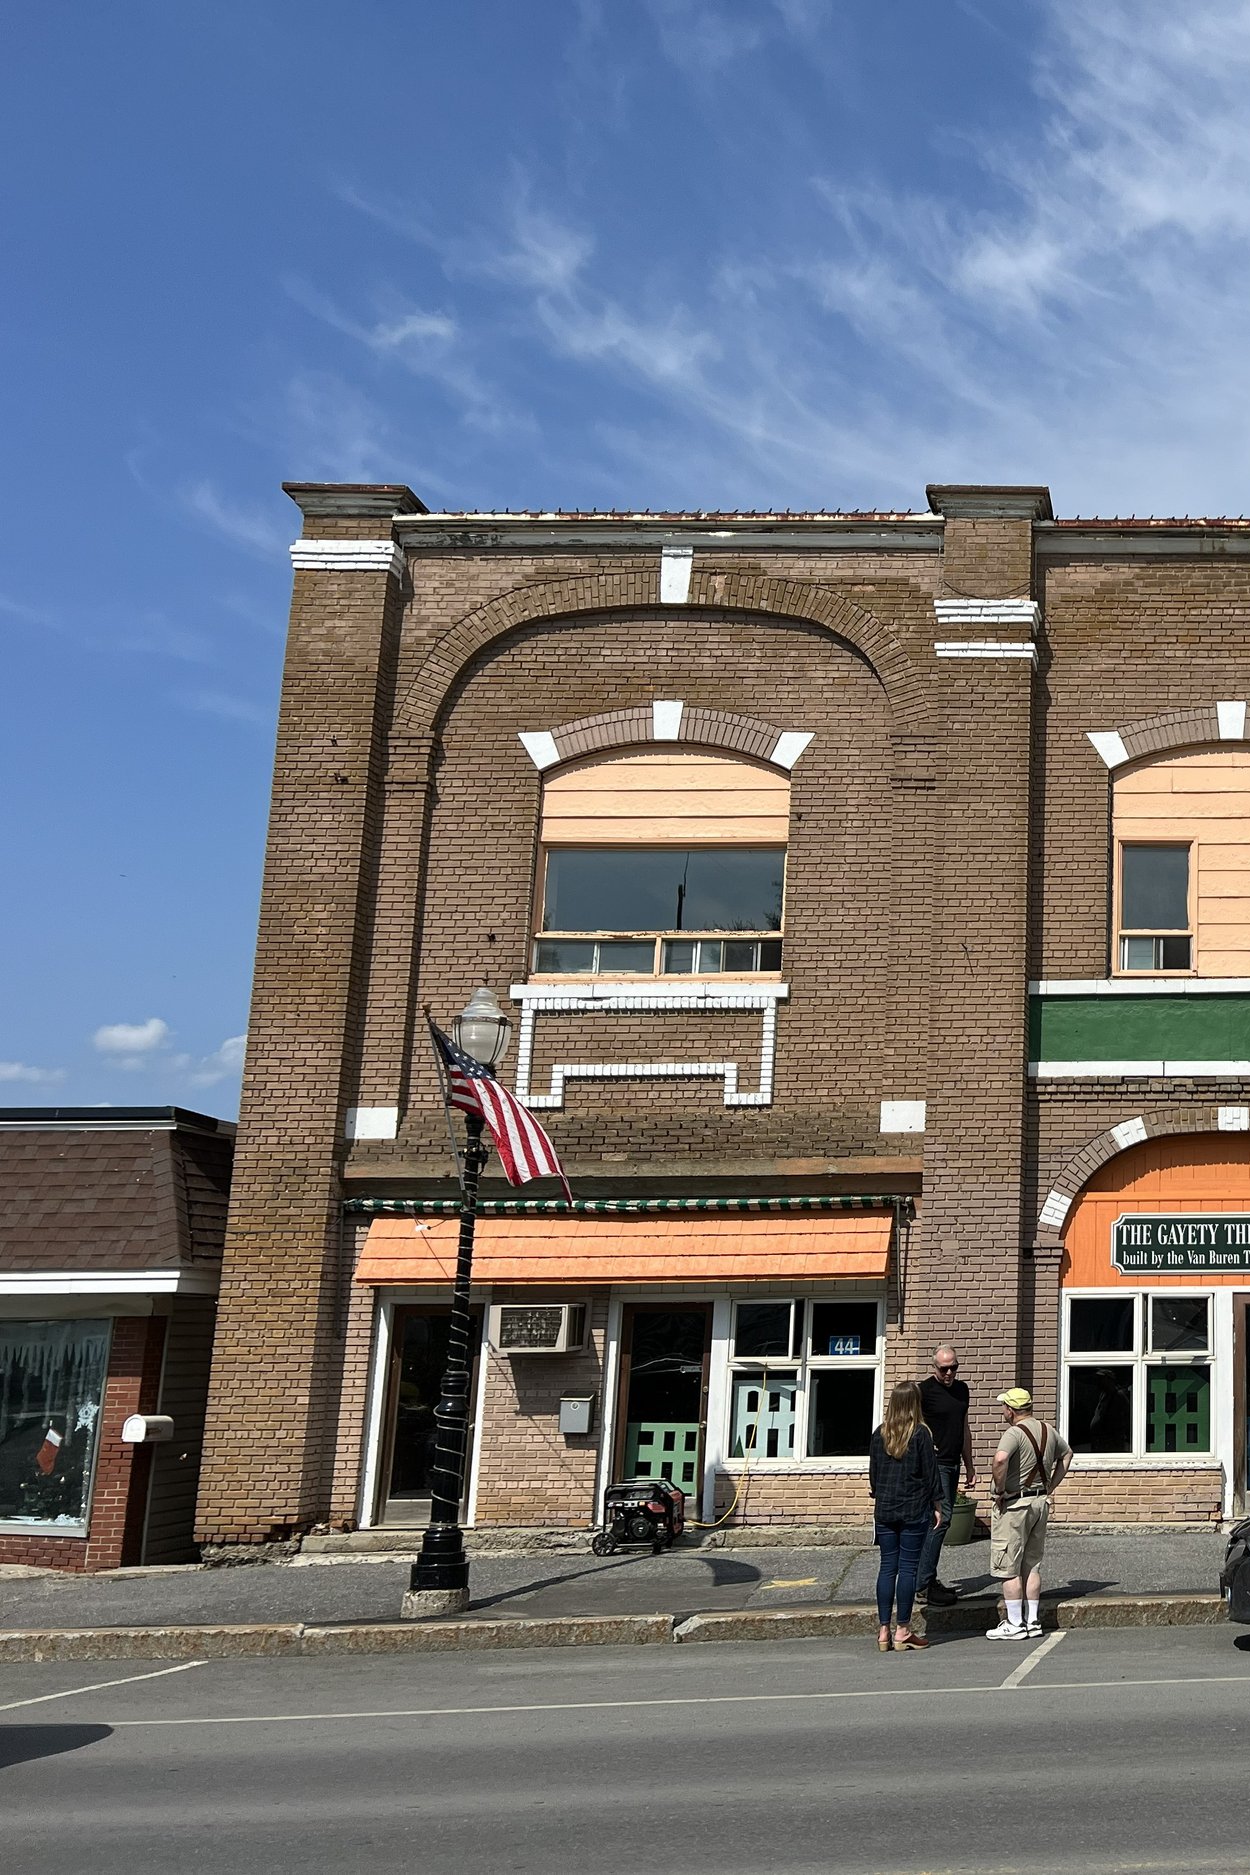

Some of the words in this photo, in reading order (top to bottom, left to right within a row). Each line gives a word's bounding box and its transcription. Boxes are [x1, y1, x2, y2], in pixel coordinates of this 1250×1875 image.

[1119, 1224, 1152, 1245] THE
[1157, 1223, 1219, 1245] GAYETY
[1123, 1250, 1148, 1265] built
[1151, 1250, 1164, 1268] by
[1167, 1250, 1184, 1265] the
[1187, 1249, 1206, 1265] Van
[1209, 1249, 1241, 1265] Buren
[834, 1337, 854, 1355] 44
